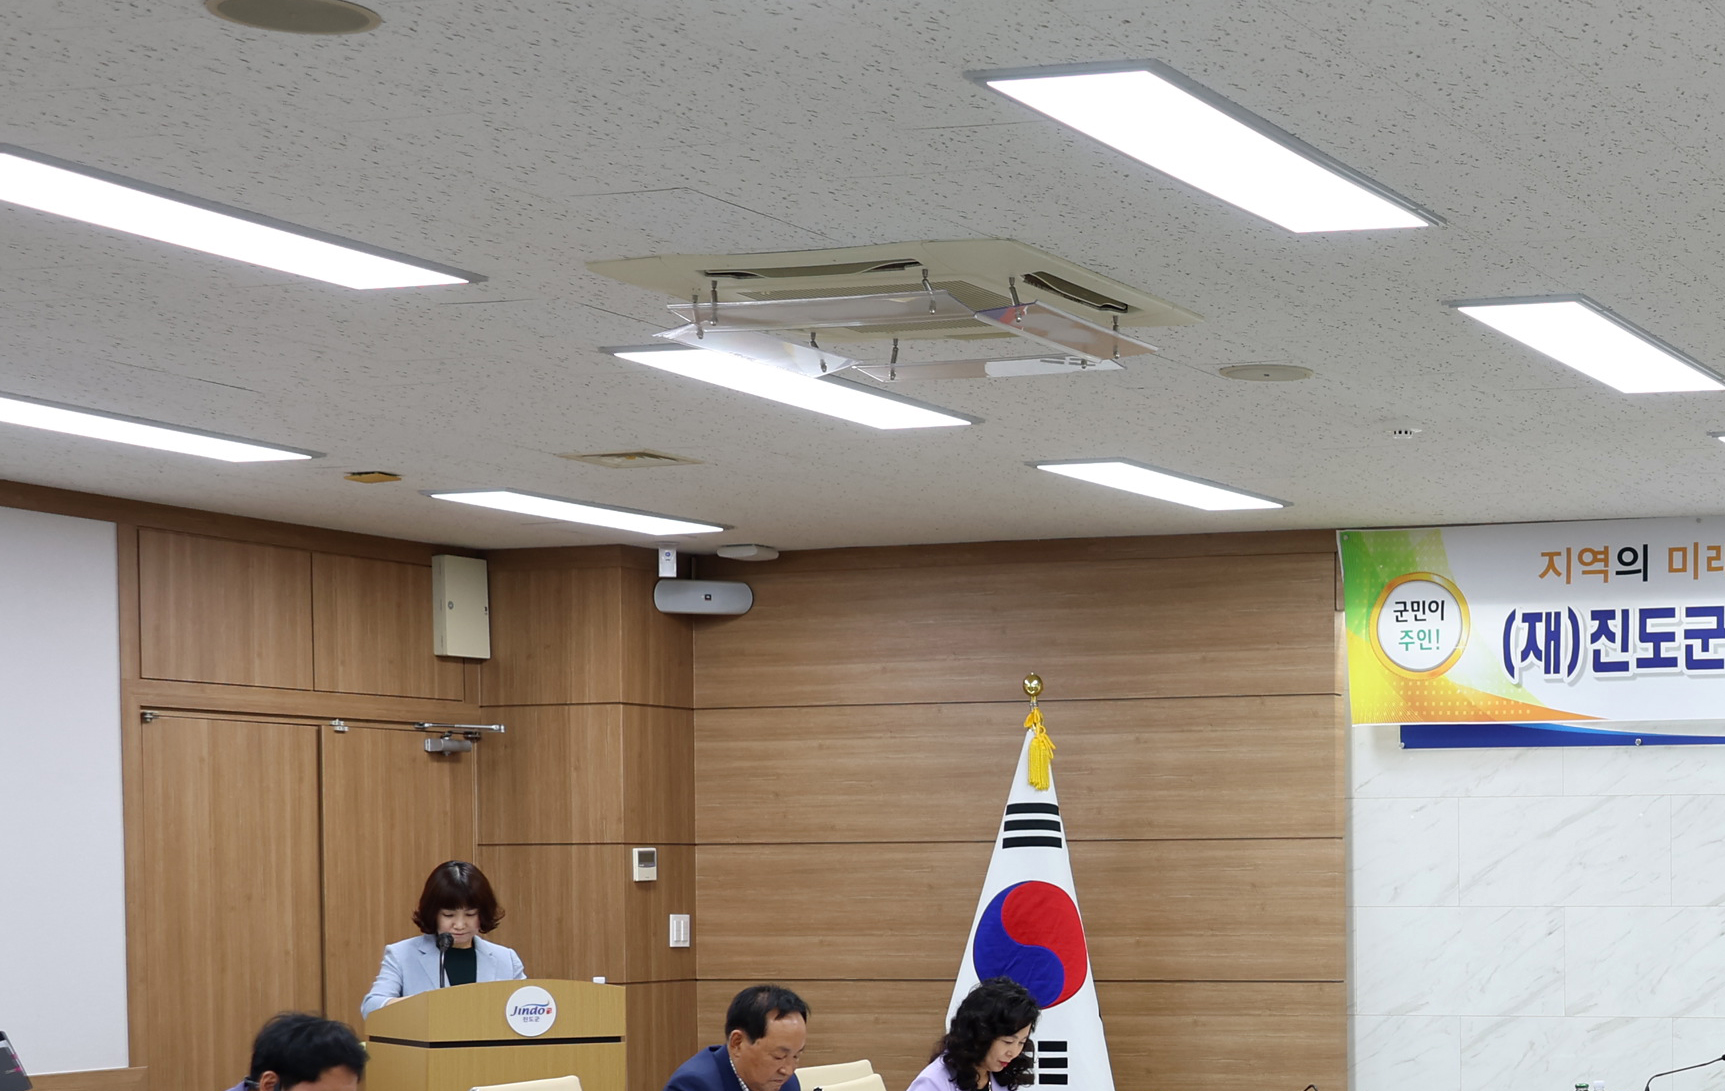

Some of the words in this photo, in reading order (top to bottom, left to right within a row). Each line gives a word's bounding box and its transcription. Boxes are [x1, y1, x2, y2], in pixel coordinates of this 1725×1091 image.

[1539, 543, 1650, 584] 지역의
[1393, 600, 1446, 623] 군민이
[1398, 629, 1441, 651] 주인!
[510, 1005, 546, 1016] Jindo
